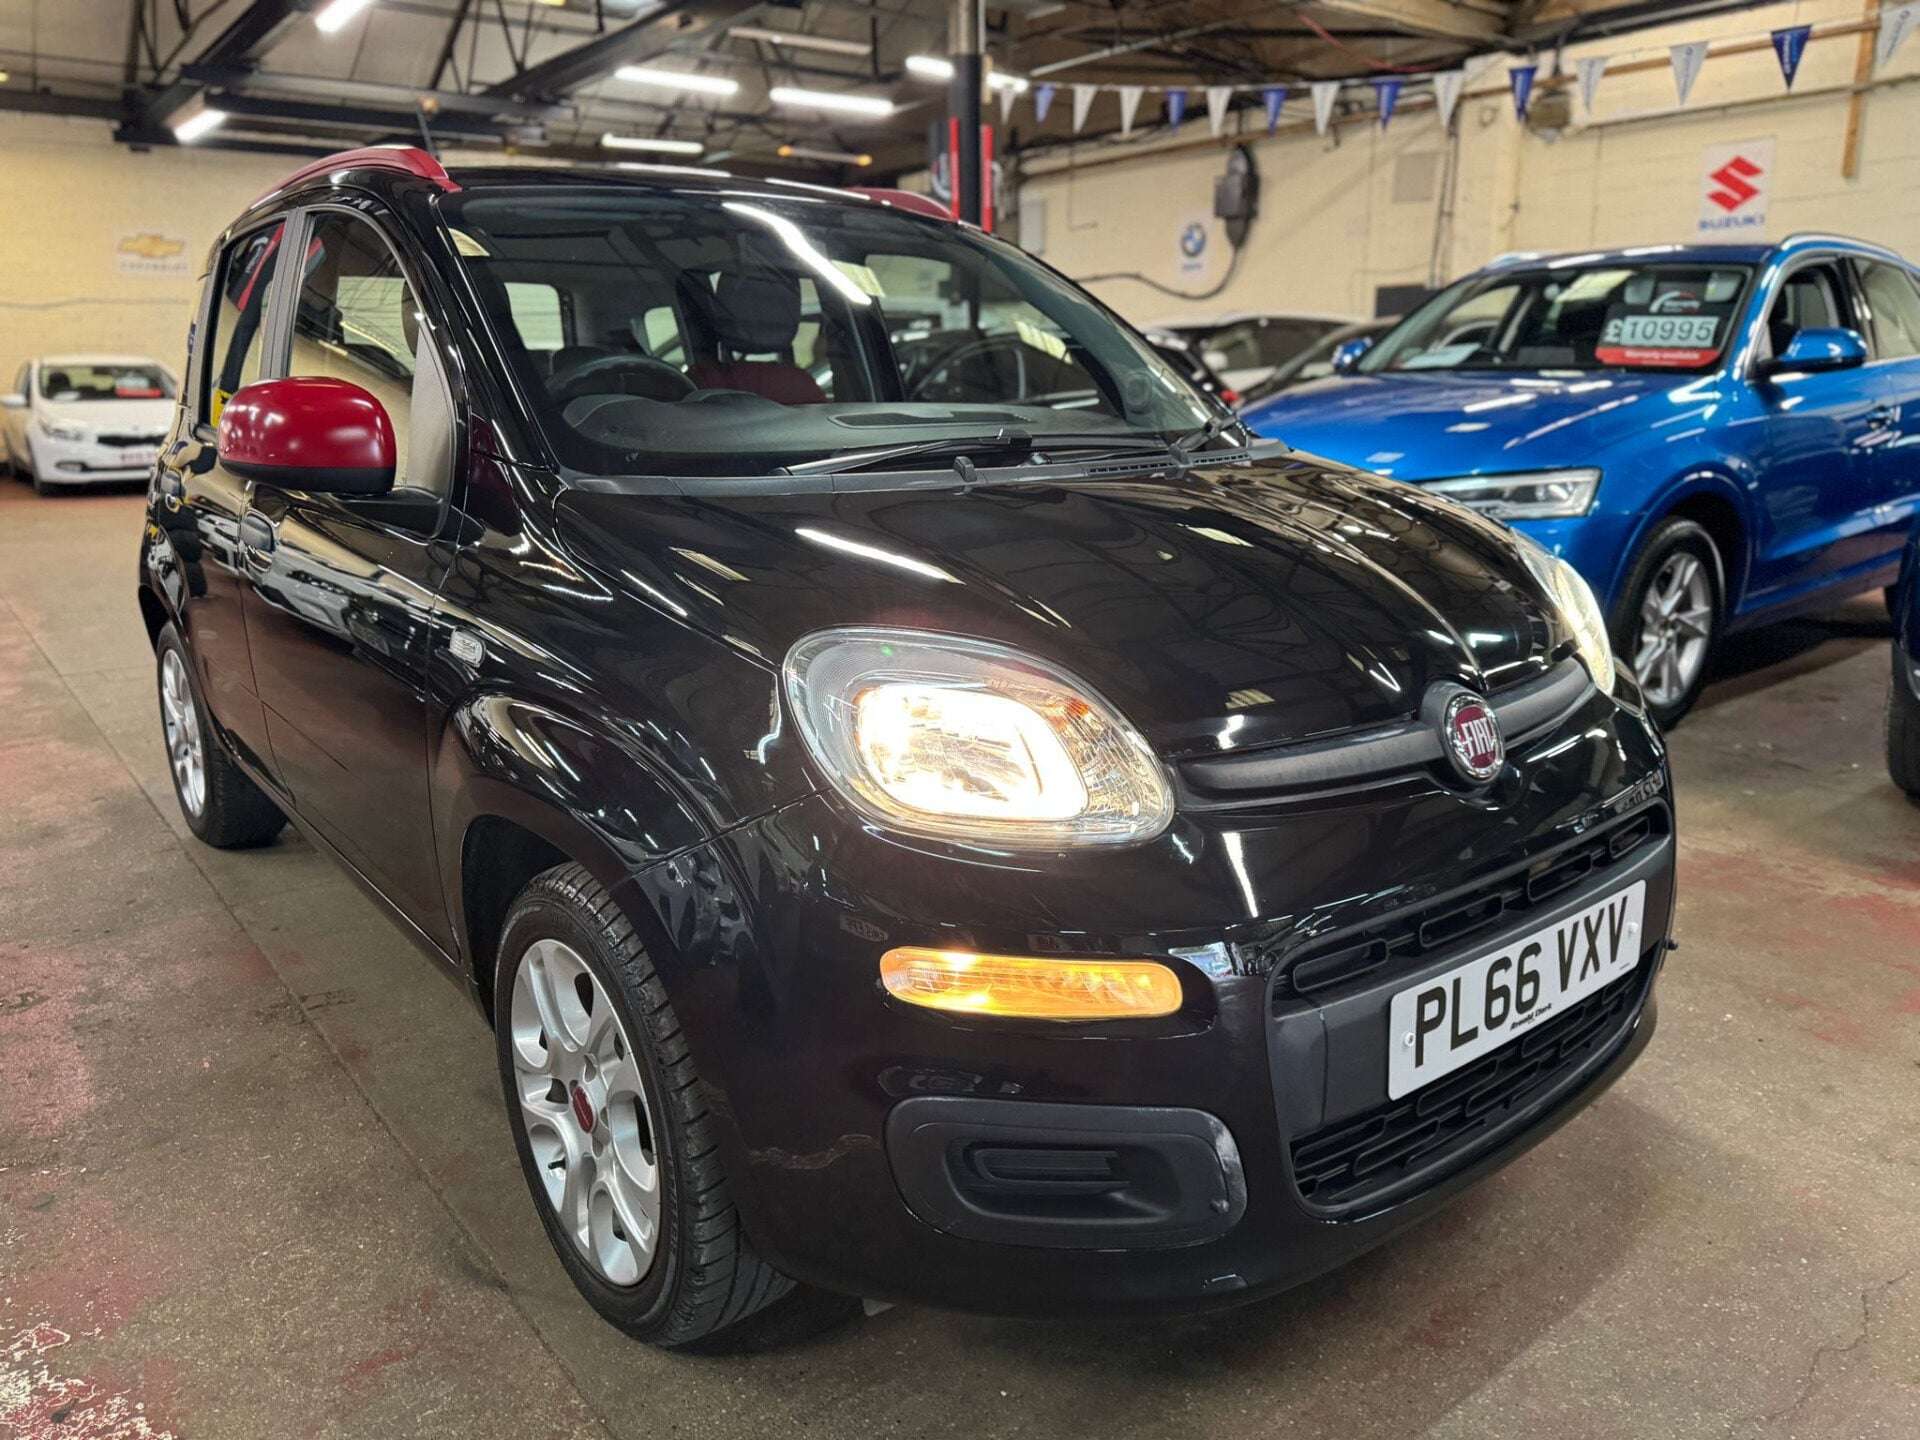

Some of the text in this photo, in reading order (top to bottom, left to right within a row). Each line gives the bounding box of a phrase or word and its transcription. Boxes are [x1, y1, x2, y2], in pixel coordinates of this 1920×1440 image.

[1699, 214, 1765, 230] SUZUKI
[1460, 717, 1494, 758] FIAT
[1415, 895, 1628, 1068] PL66 VXV
